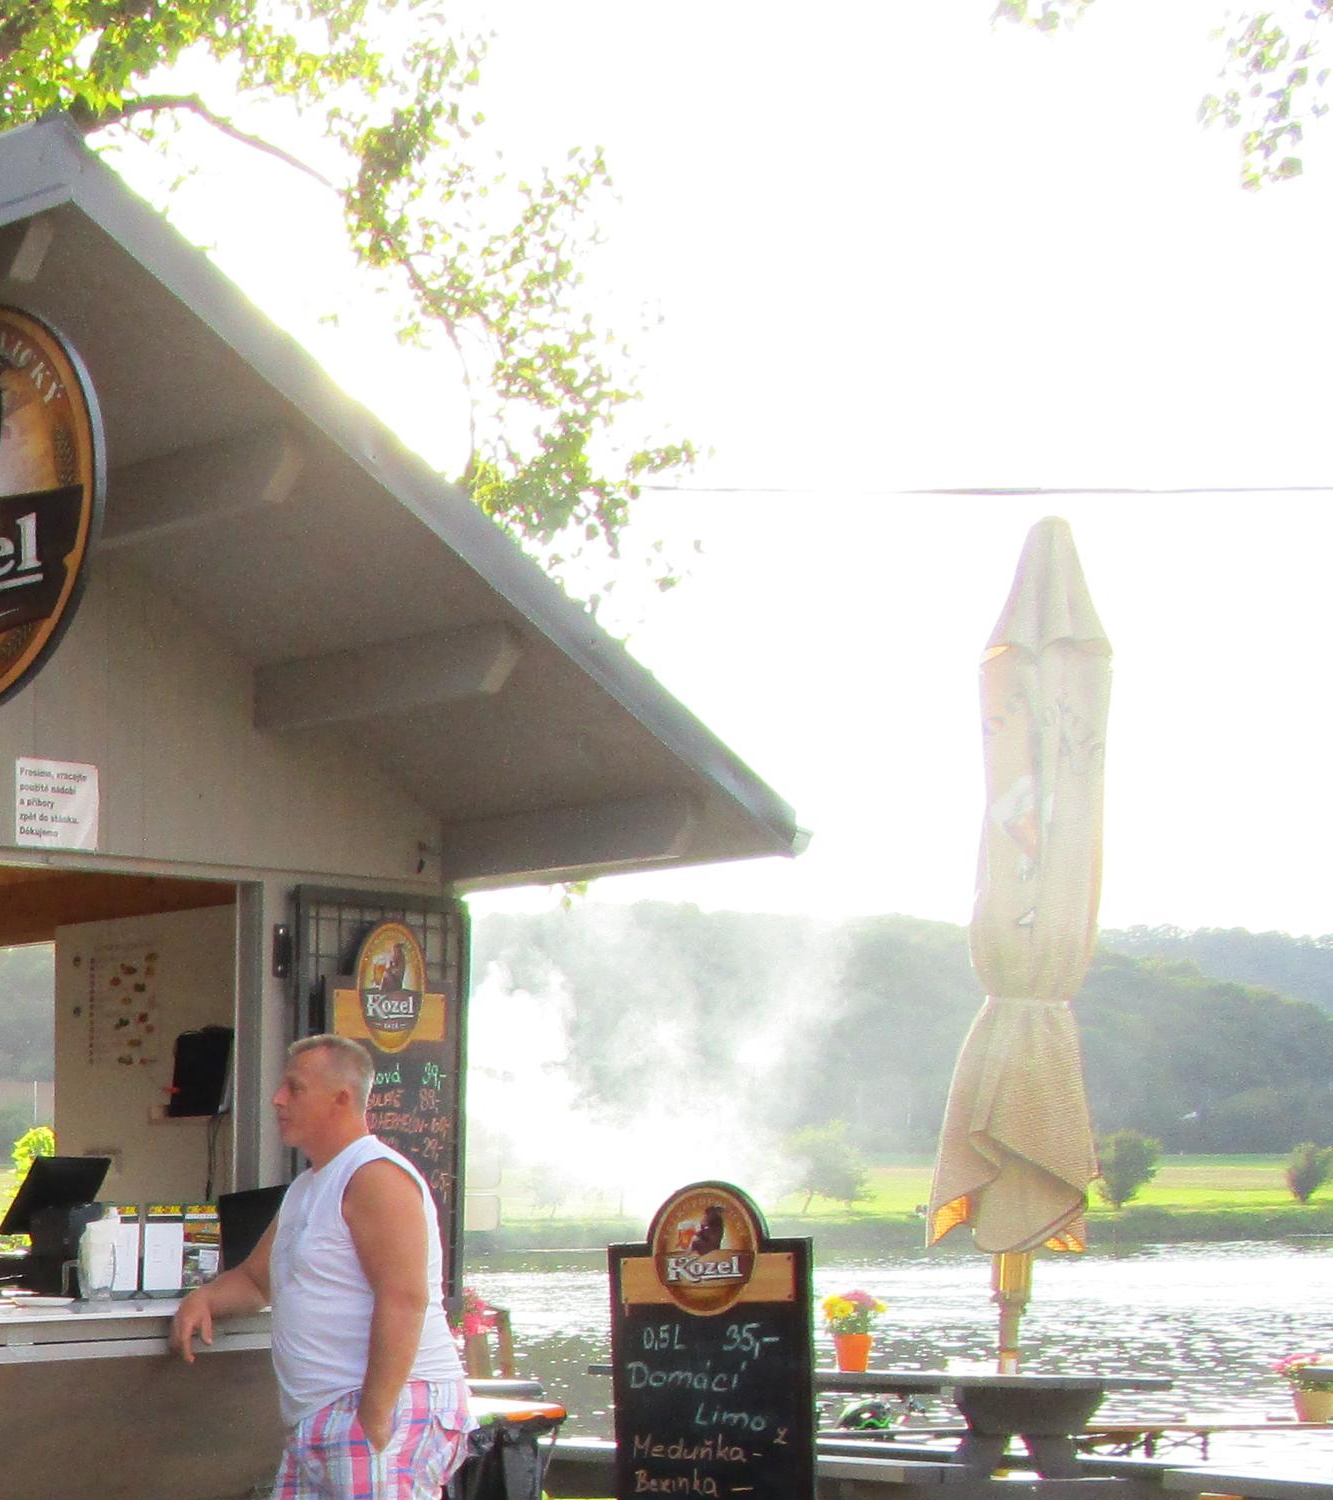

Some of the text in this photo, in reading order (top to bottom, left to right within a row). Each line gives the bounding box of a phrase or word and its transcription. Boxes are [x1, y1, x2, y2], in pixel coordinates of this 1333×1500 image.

[365, 994, 415, 1019] Kozel
[667, 1255, 743, 1283] Kozel
[627, 1359, 748, 1392] Domácí
[694, 1402, 767, 1432] Limo
[633, 1432, 748, 1464] Meduňka
